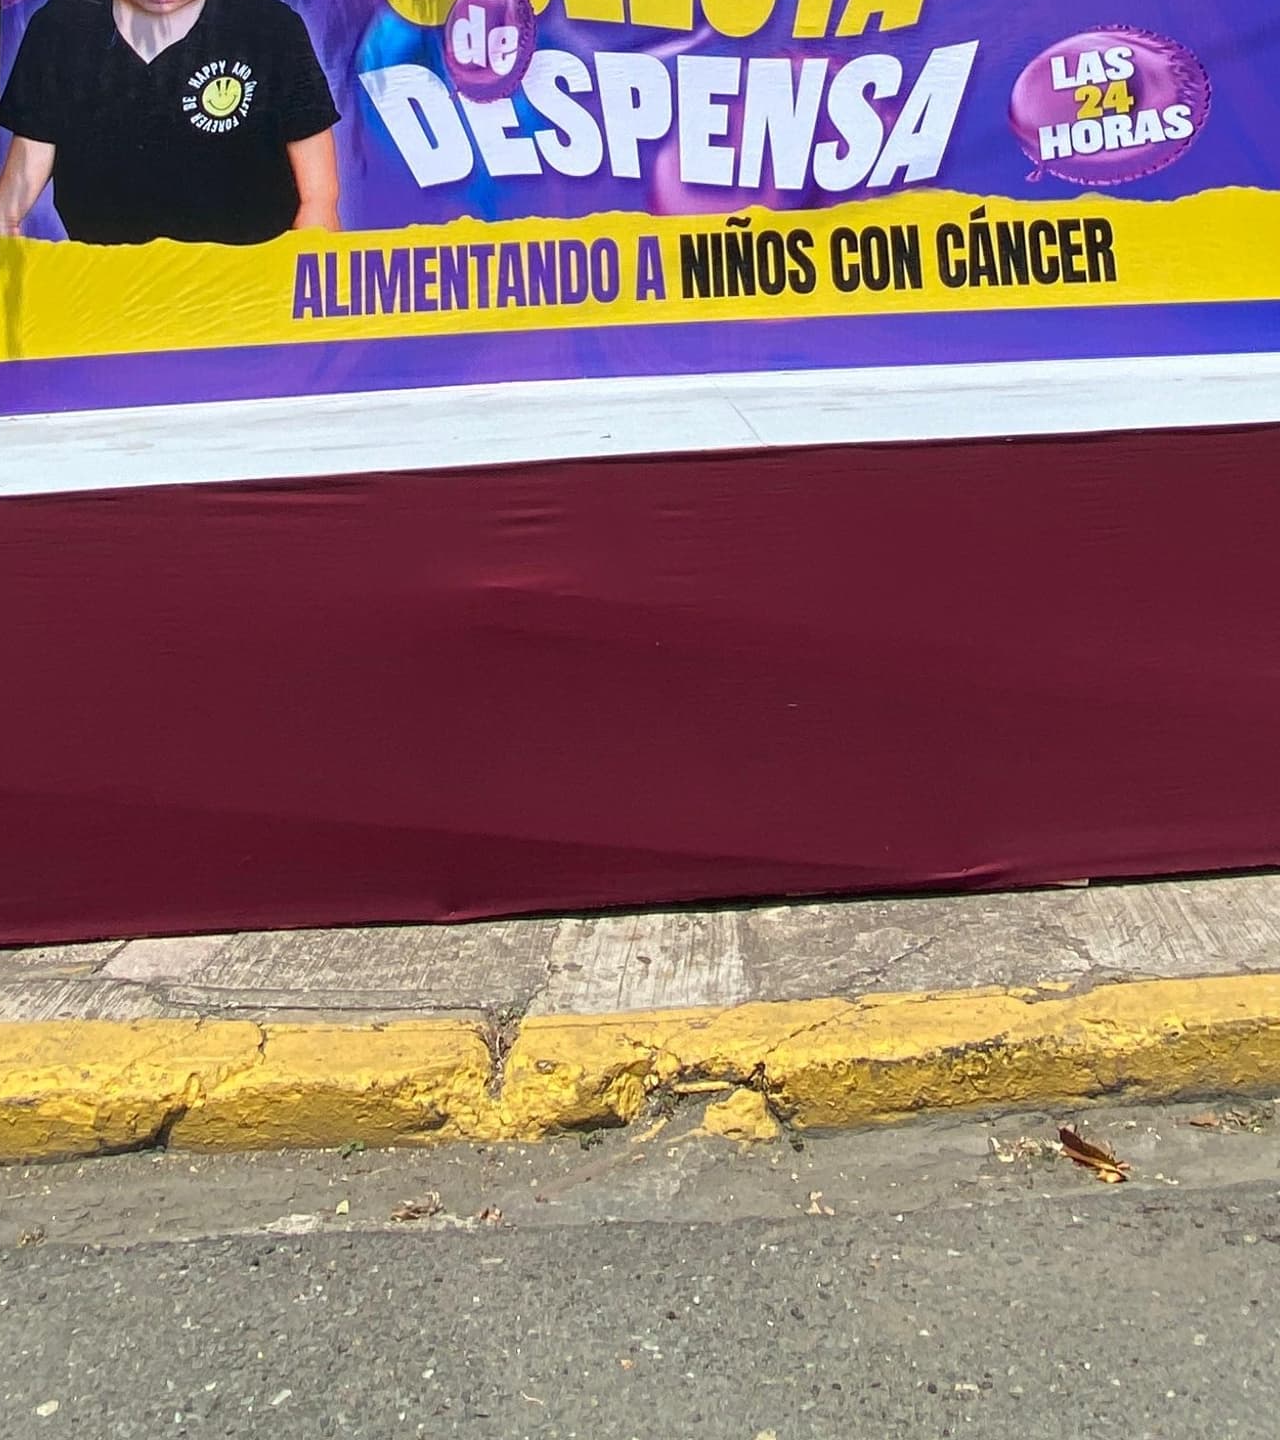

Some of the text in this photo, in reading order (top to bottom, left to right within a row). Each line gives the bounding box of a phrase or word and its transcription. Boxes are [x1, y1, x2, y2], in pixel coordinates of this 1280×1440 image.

[452, 4, 518, 76] de
[188, 60, 226, 89] HAPPY
[231, 61, 252, 81] AND
[1050, 45, 1135, 91] LAS
[182, 95, 197, 111] BE
[359, 38, 981, 192] DESPENSA
[1074, 80, 1134, 120] 24
[190, 112, 240, 133] FOREVER
[1038, 104, 1194, 161] HORAS
[292, 204, 1117, 320] ALIMENTANDO A NIÑOS CON CÁNCER
